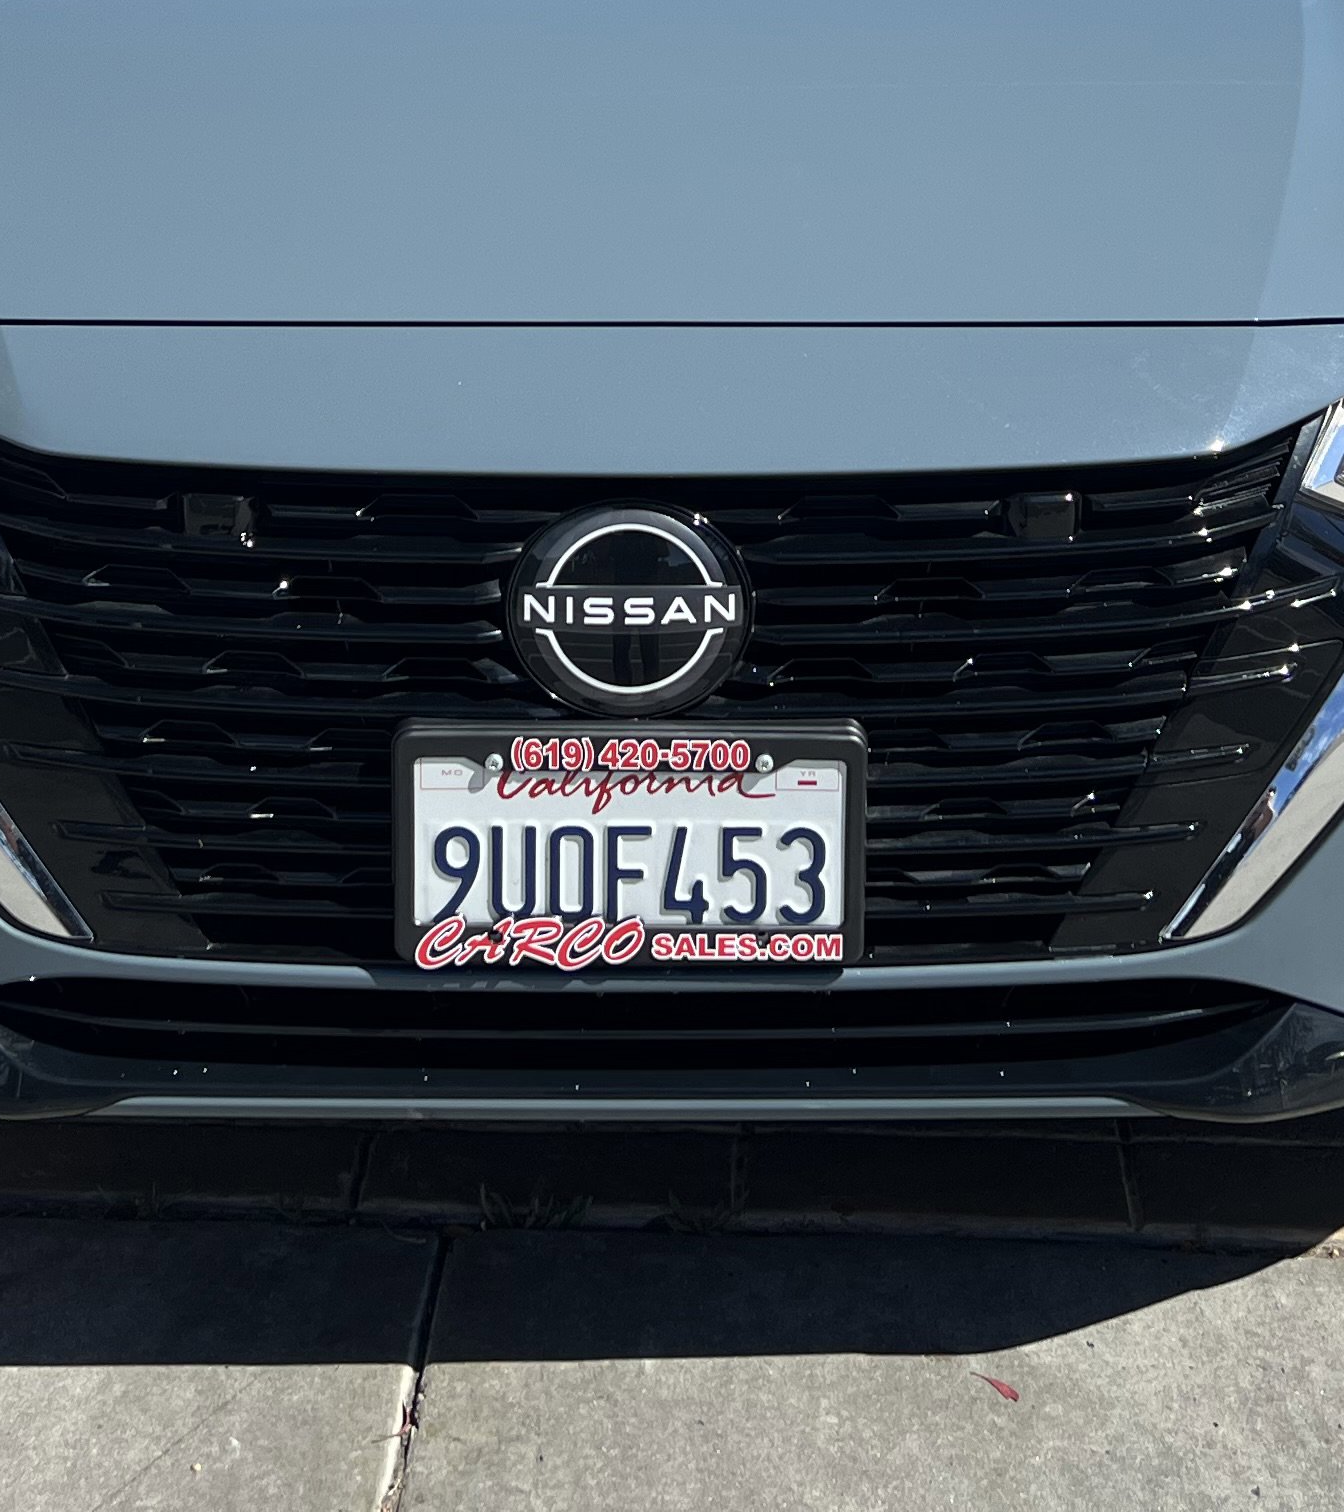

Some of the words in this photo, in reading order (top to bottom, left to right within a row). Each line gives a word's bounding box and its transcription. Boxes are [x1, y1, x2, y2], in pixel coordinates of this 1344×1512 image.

[523, 593, 736, 626] NISSAN
[511, 737, 594, 771] (619)
[599, 738, 751, 771] 420-5700
[441, 768, 464, 776] MO
[497, 770, 776, 814] California
[415, 915, 645, 971] CARCO
[650, 932, 844, 961] SALES.COM
